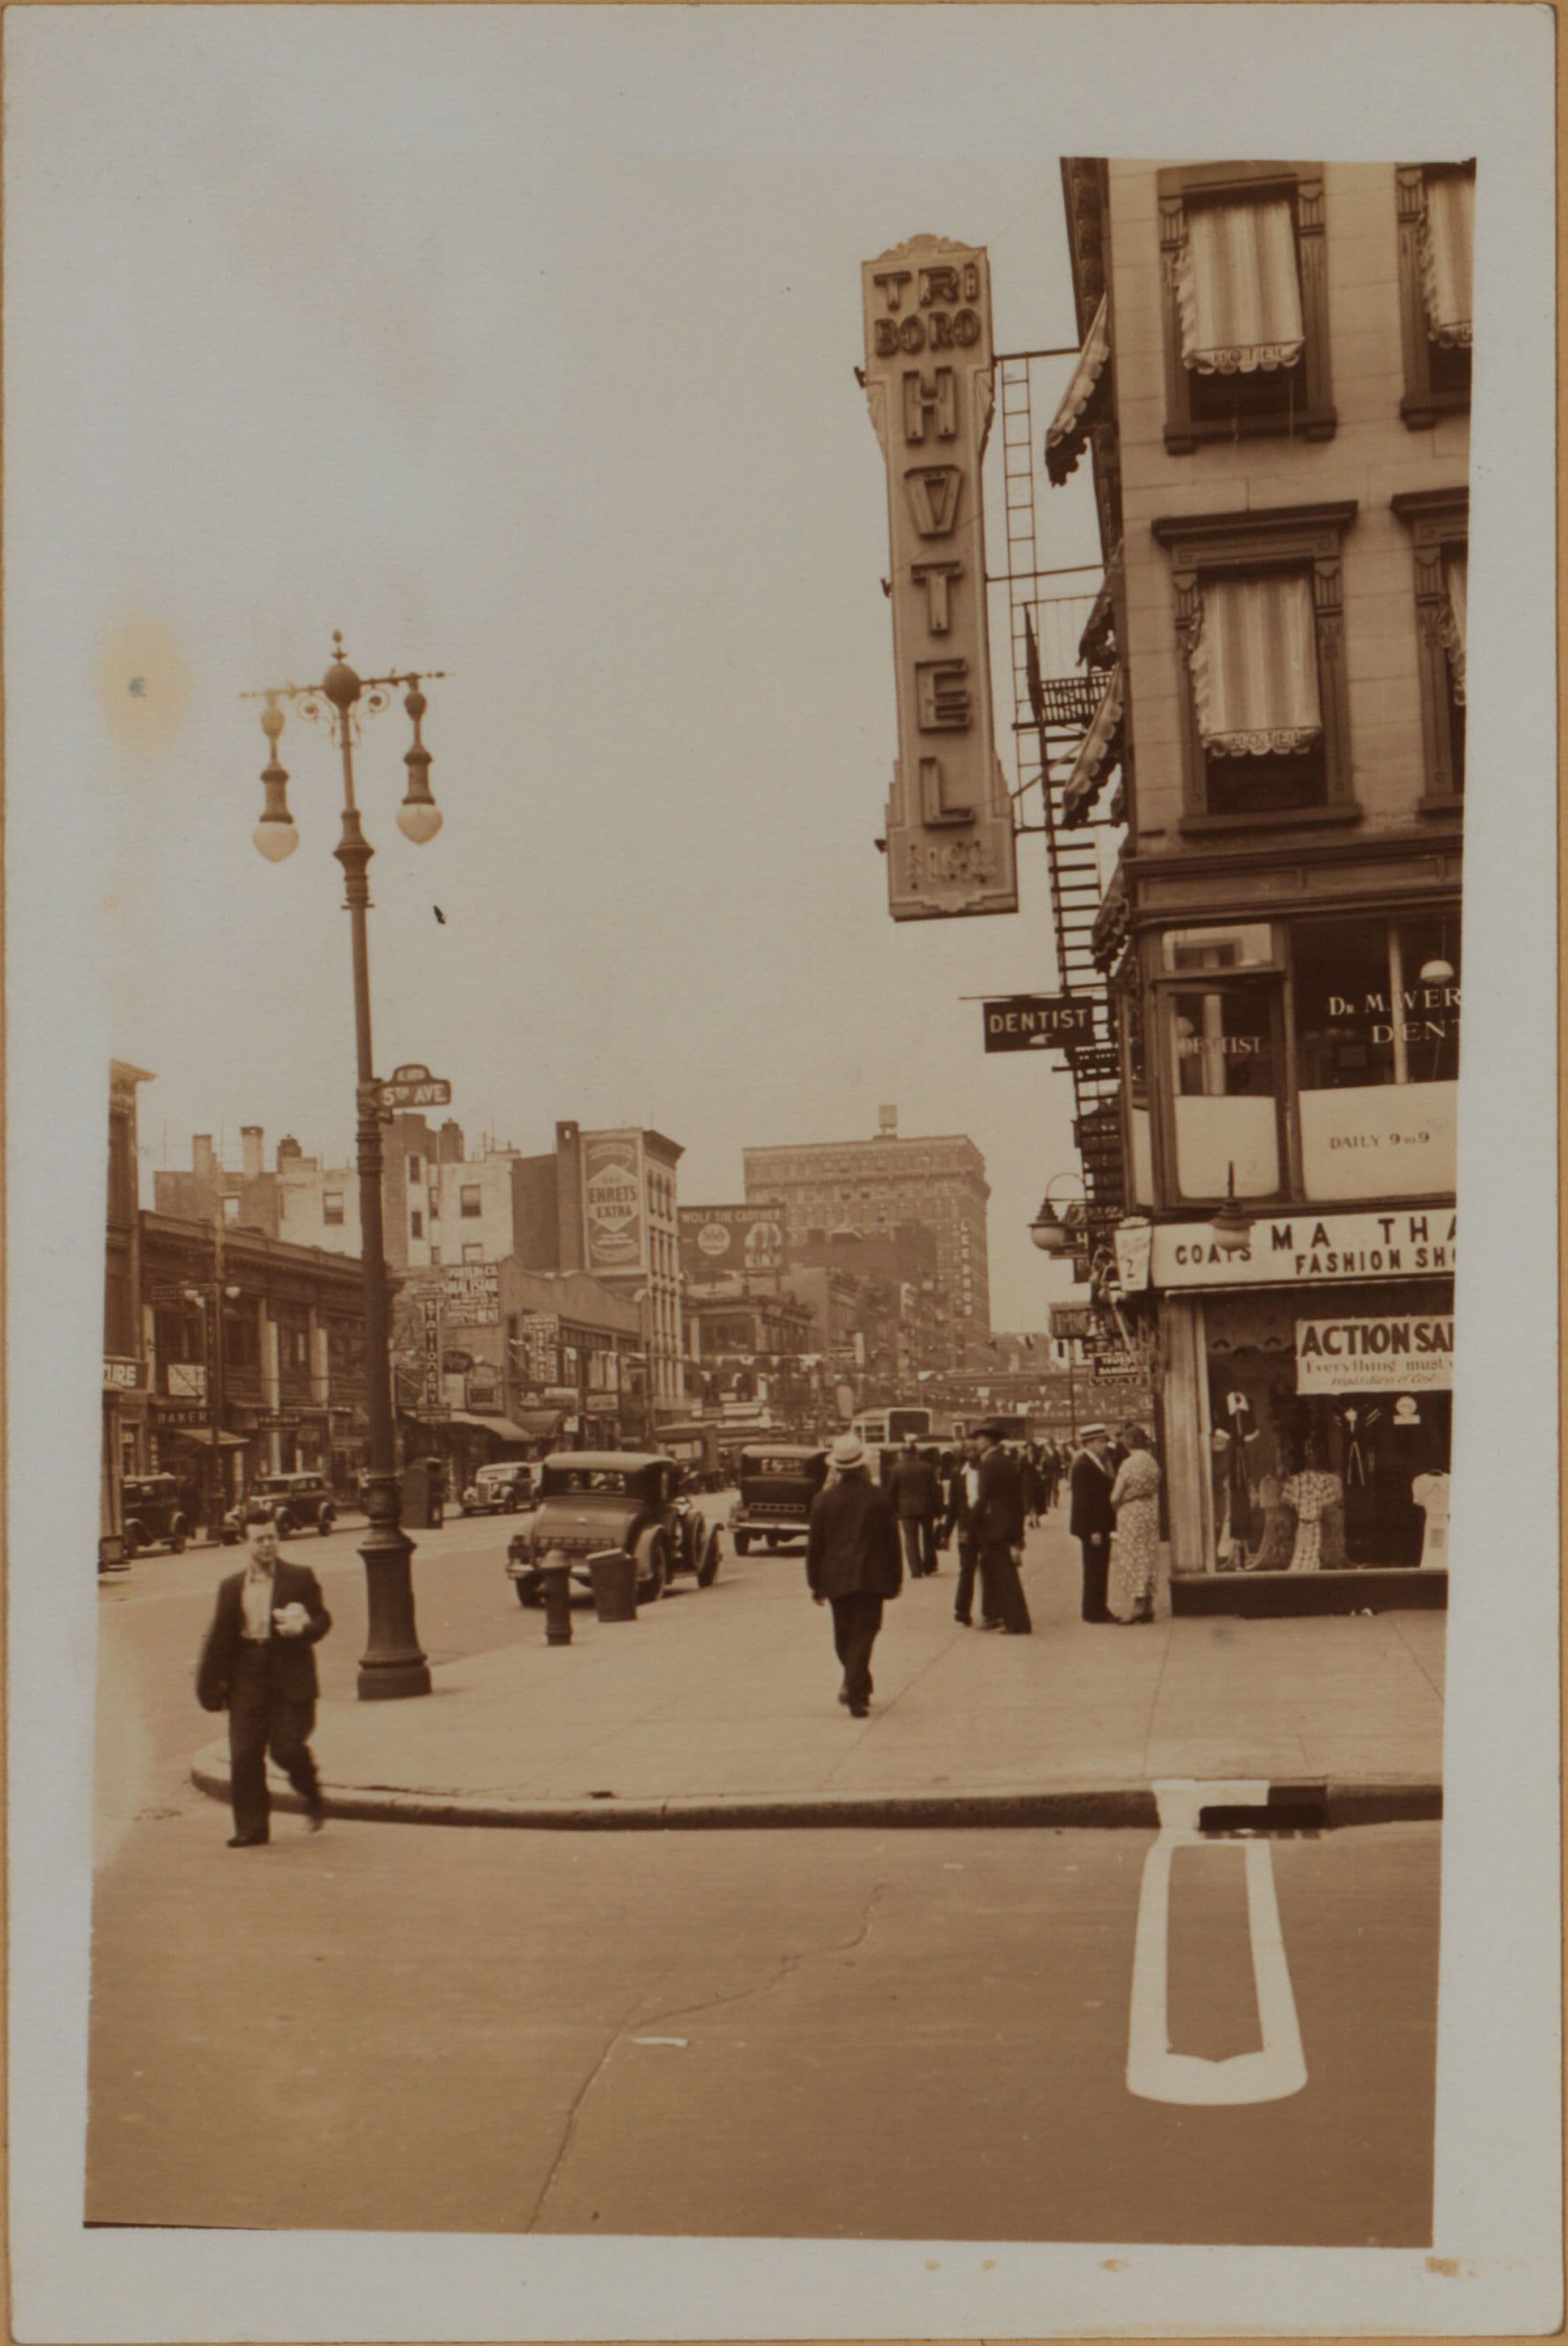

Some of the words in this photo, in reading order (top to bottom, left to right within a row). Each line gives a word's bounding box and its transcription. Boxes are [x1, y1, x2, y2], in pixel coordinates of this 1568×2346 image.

[873, 263, 980, 312] TRI
[874, 307, 982, 359] BORO
[903, 367, 975, 833] HOTEL
[989, 1009, 1088, 1033] DENTIST
[1330, 1134, 1380, 1150] DAILY
[1388, 1132, 1401, 1145] 9
[1418, 1131, 1430, 1143] 9
[596, 1206, 632, 1219] EXTRA
[1295, 1250, 1402, 1275] FASHION
[1415, 1246, 1455, 1268] SH
[425, 1299, 438, 1404] STATIONERY
[1301, 1322, 1410, 1357] ACTION
[1306, 1358, 1397, 1375] Everything
[1406, 1357, 1445, 1371] must
